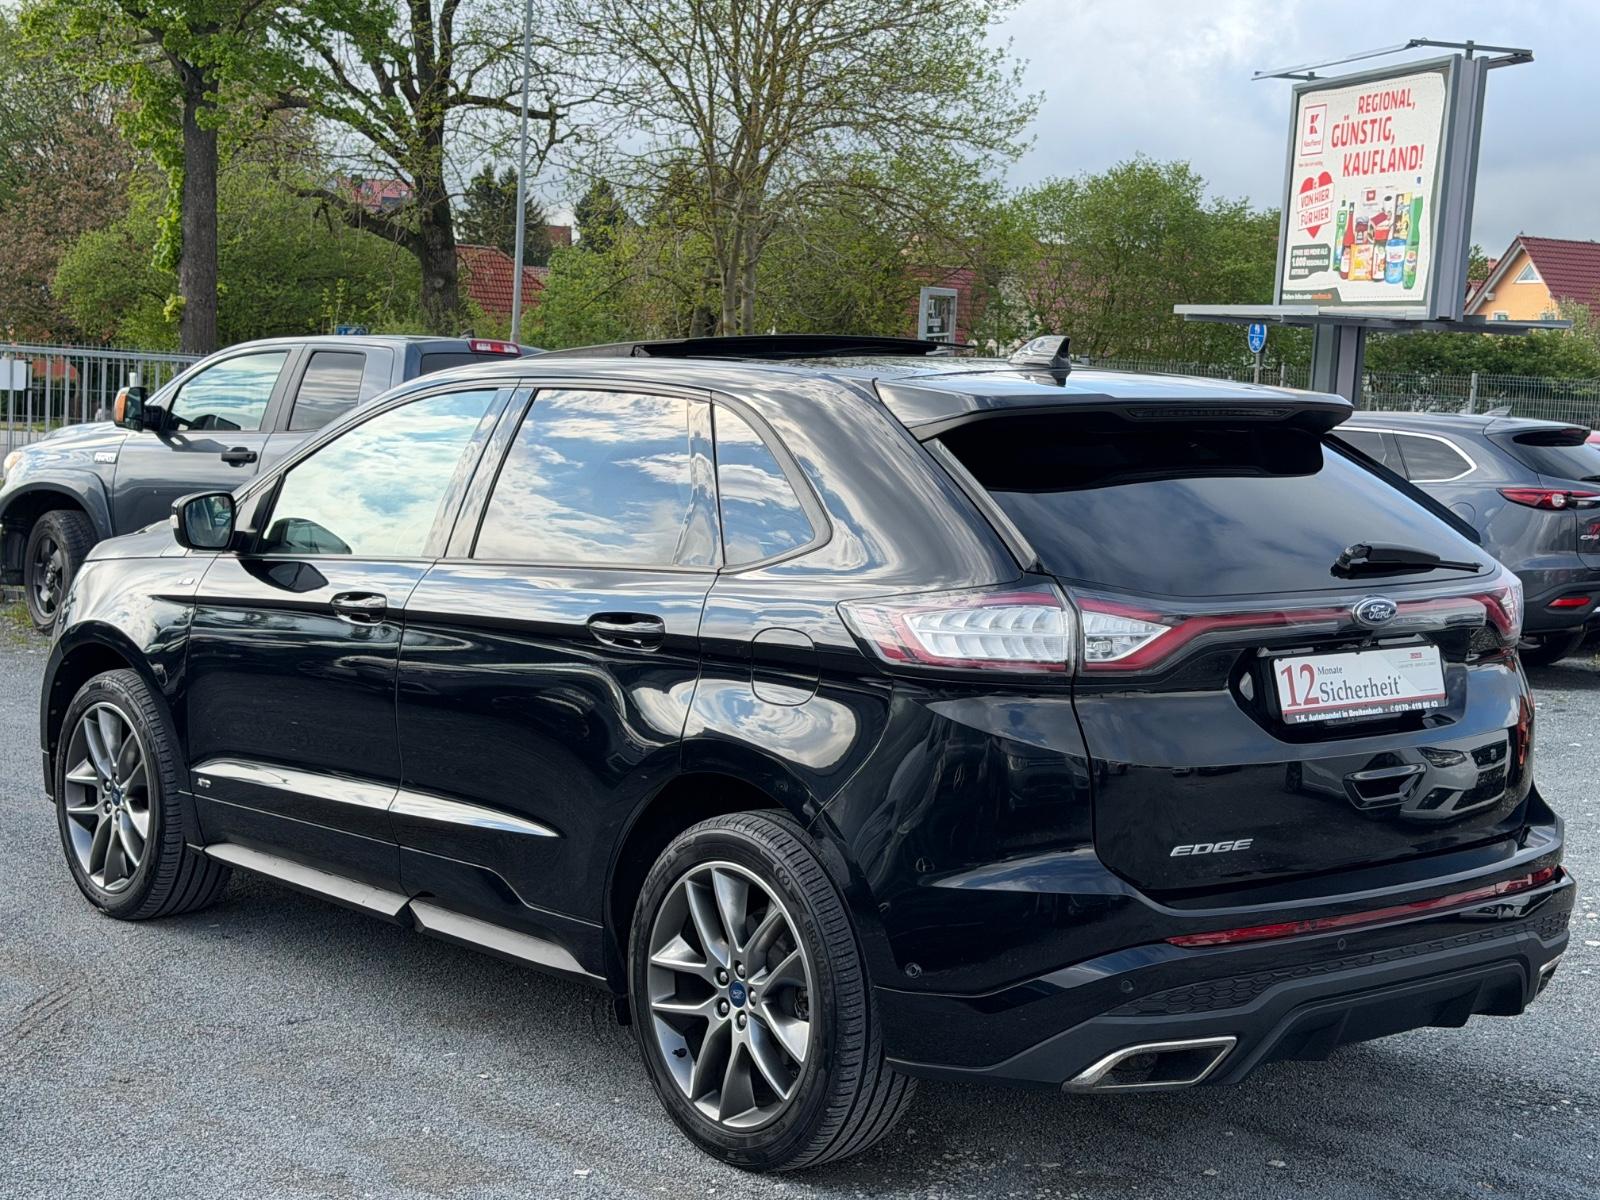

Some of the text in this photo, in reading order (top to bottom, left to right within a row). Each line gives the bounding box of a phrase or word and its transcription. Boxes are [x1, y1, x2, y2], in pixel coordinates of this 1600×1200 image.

[1358, 88, 1415, 114] REGIONAL,
[1331, 115, 1395, 148] GÜNSTIG,
[1343, 144, 1424, 177] KAUFLAND!
[1301, 188, 1330, 208] VON HIER
[1301, 207, 1329, 226] FÜR HIER
[1369, 604, 1391, 619] Ford
[1317, 666, 1343, 676] Monate
[1281, 664, 1320, 707] 12
[1308, 711, 1342, 721] Autohandel
[1342, 710, 1349, 718] in
[1170, 838, 1254, 857] EDGE
